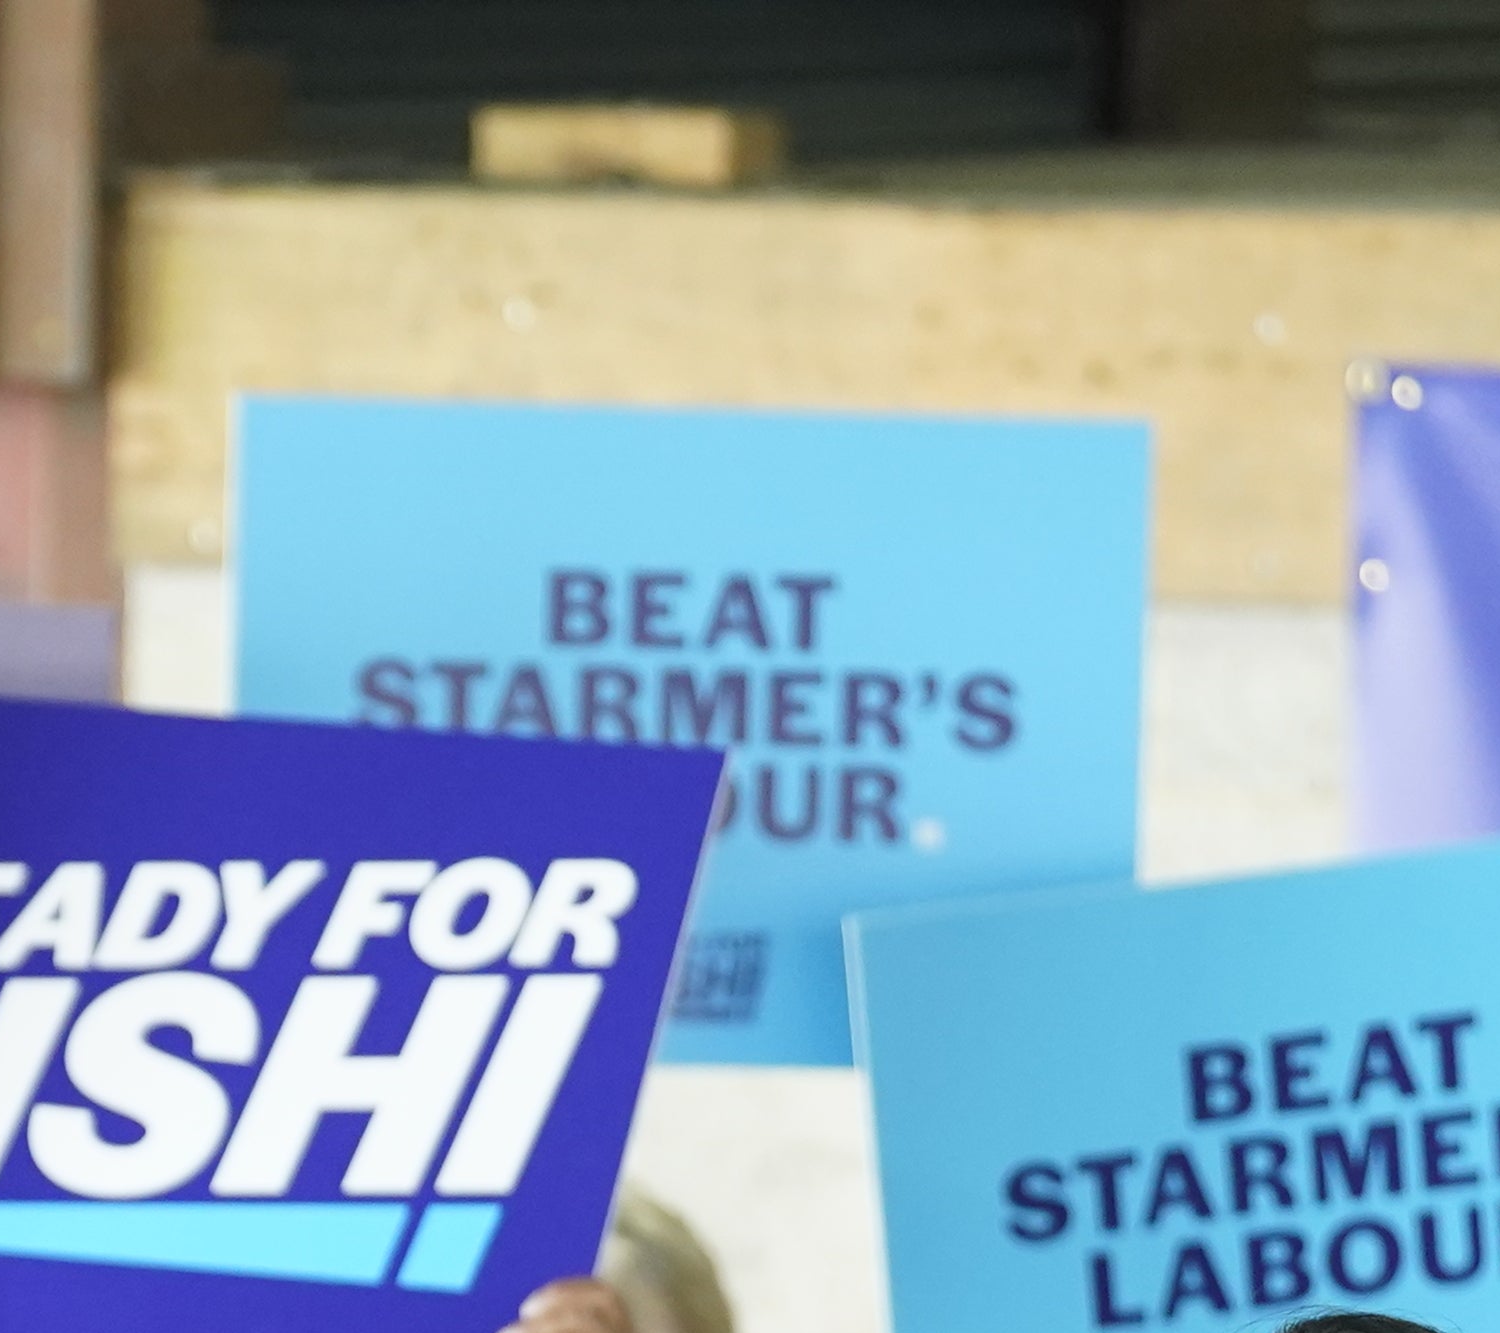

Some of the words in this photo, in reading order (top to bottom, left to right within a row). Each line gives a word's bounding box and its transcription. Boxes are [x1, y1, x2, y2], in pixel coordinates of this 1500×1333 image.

[544, 567, 838, 656] BEAT
[355, 656, 1020, 756] STARMER'S
[310, 856, 638, 972] FOR
[1183, 1013, 1480, 1126] BEAT
